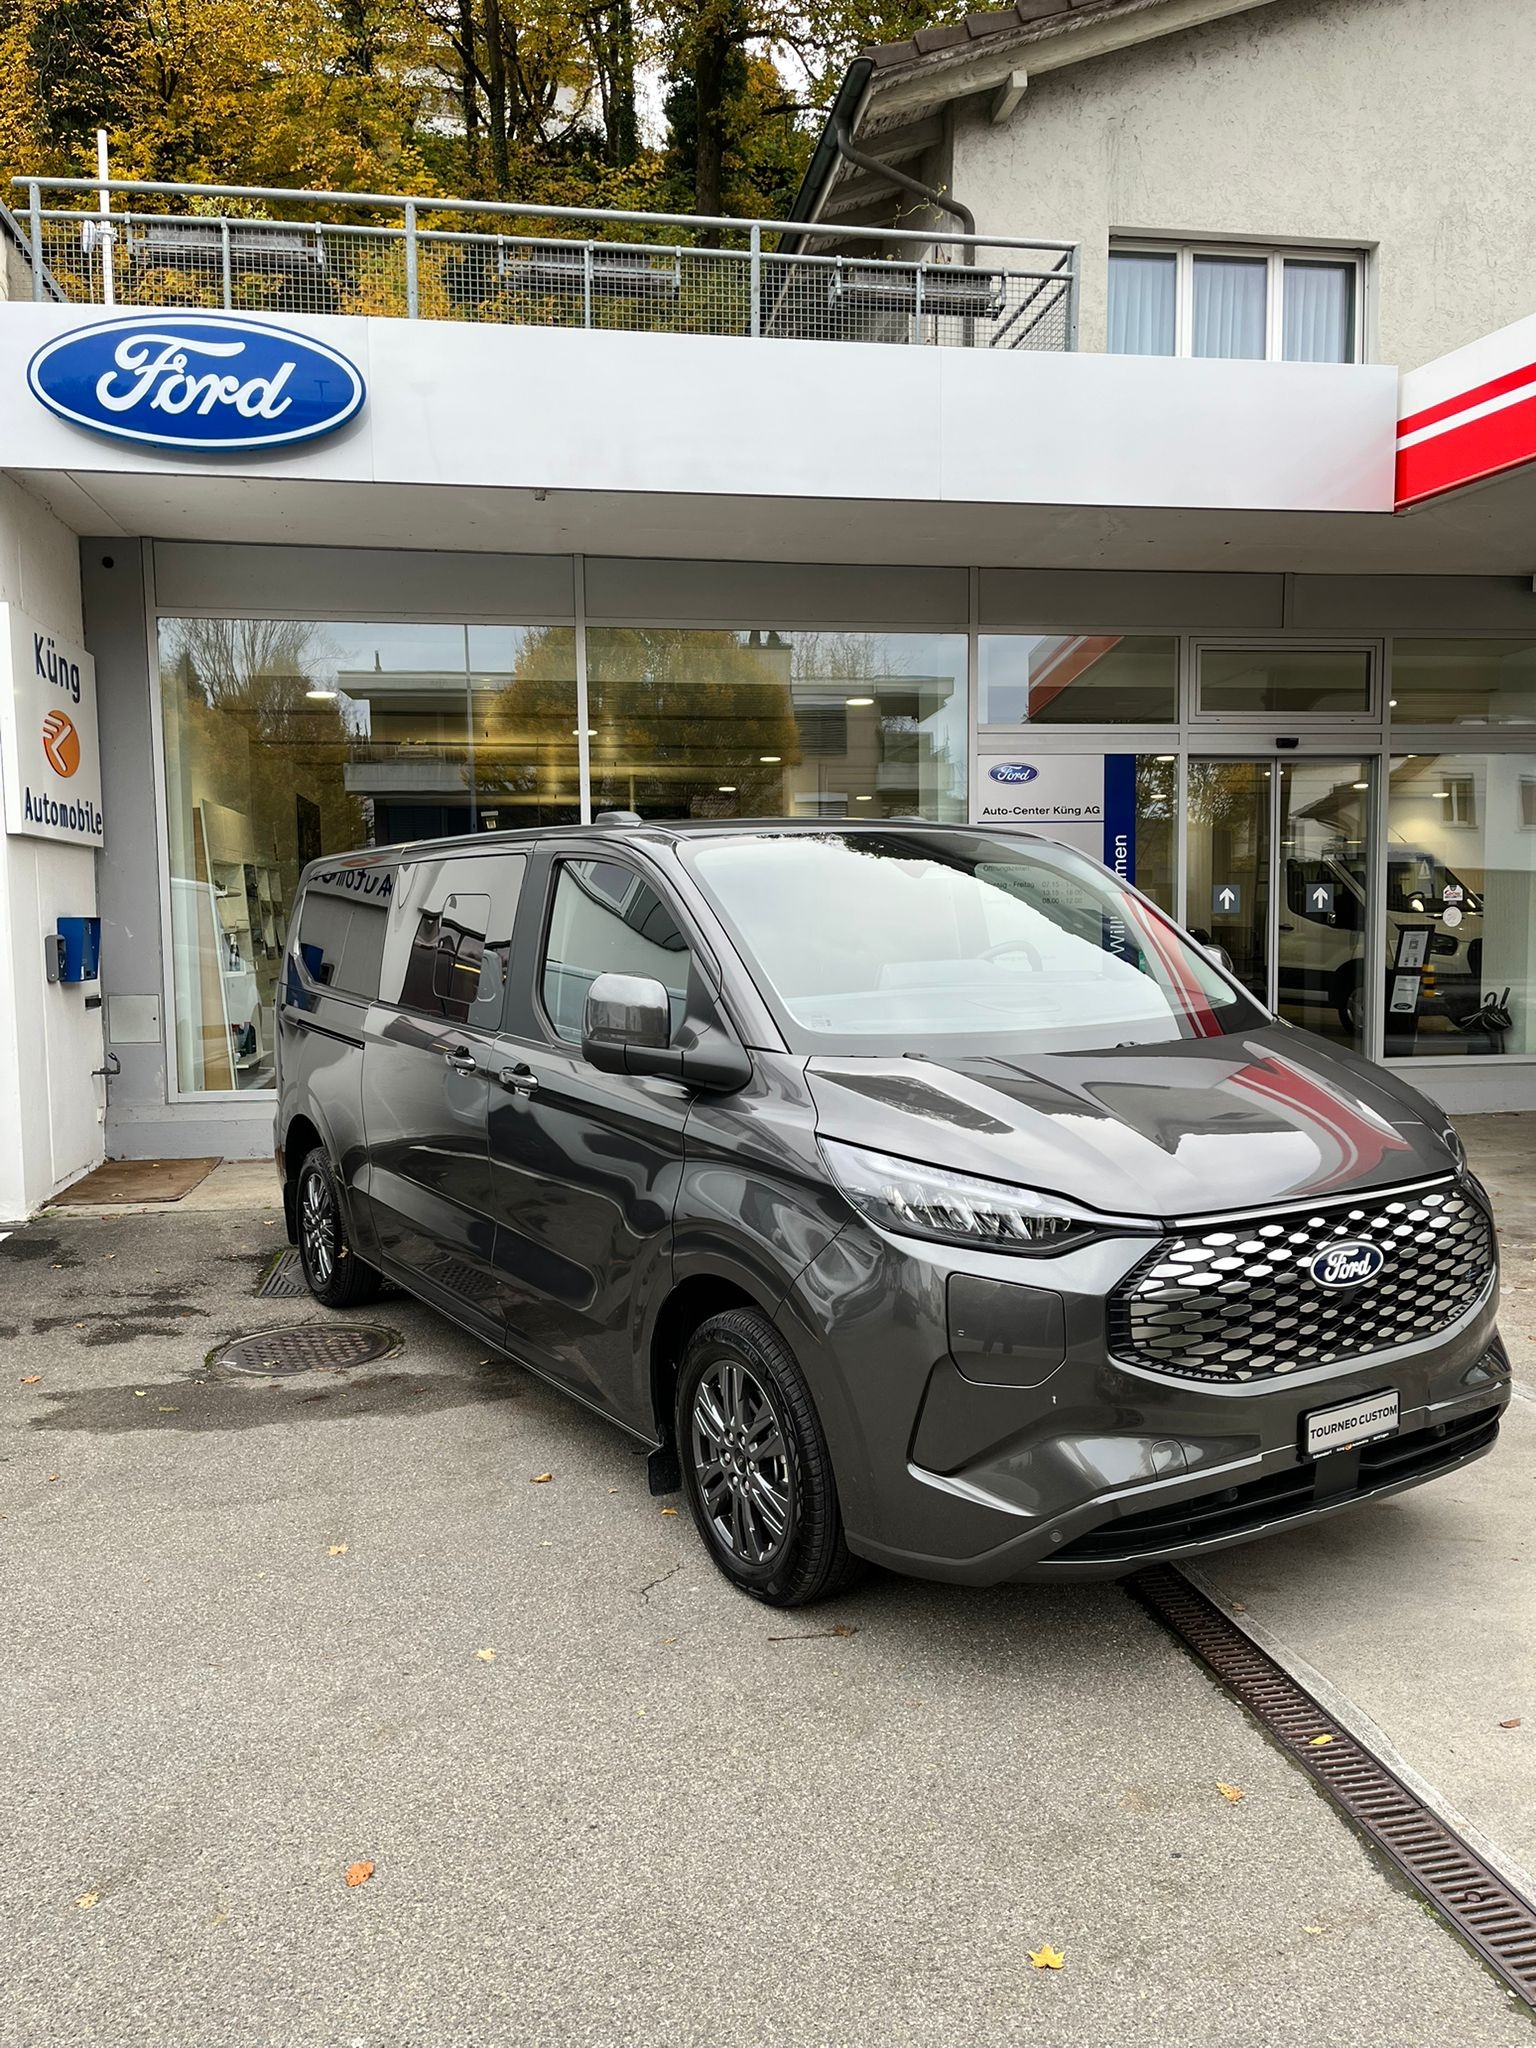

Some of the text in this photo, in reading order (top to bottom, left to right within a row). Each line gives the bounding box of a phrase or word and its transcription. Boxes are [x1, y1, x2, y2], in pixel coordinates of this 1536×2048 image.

[96, 333, 296, 420] Ford
[34, 632, 81, 703] Küng
[25, 787, 103, 835] Automobile
[982, 805, 1100, 816] Auto-Center Küng AG
[1324, 1247, 1373, 1282] Ford
[1310, 1404, 1398, 1439] TOURNEO CUSTOM
